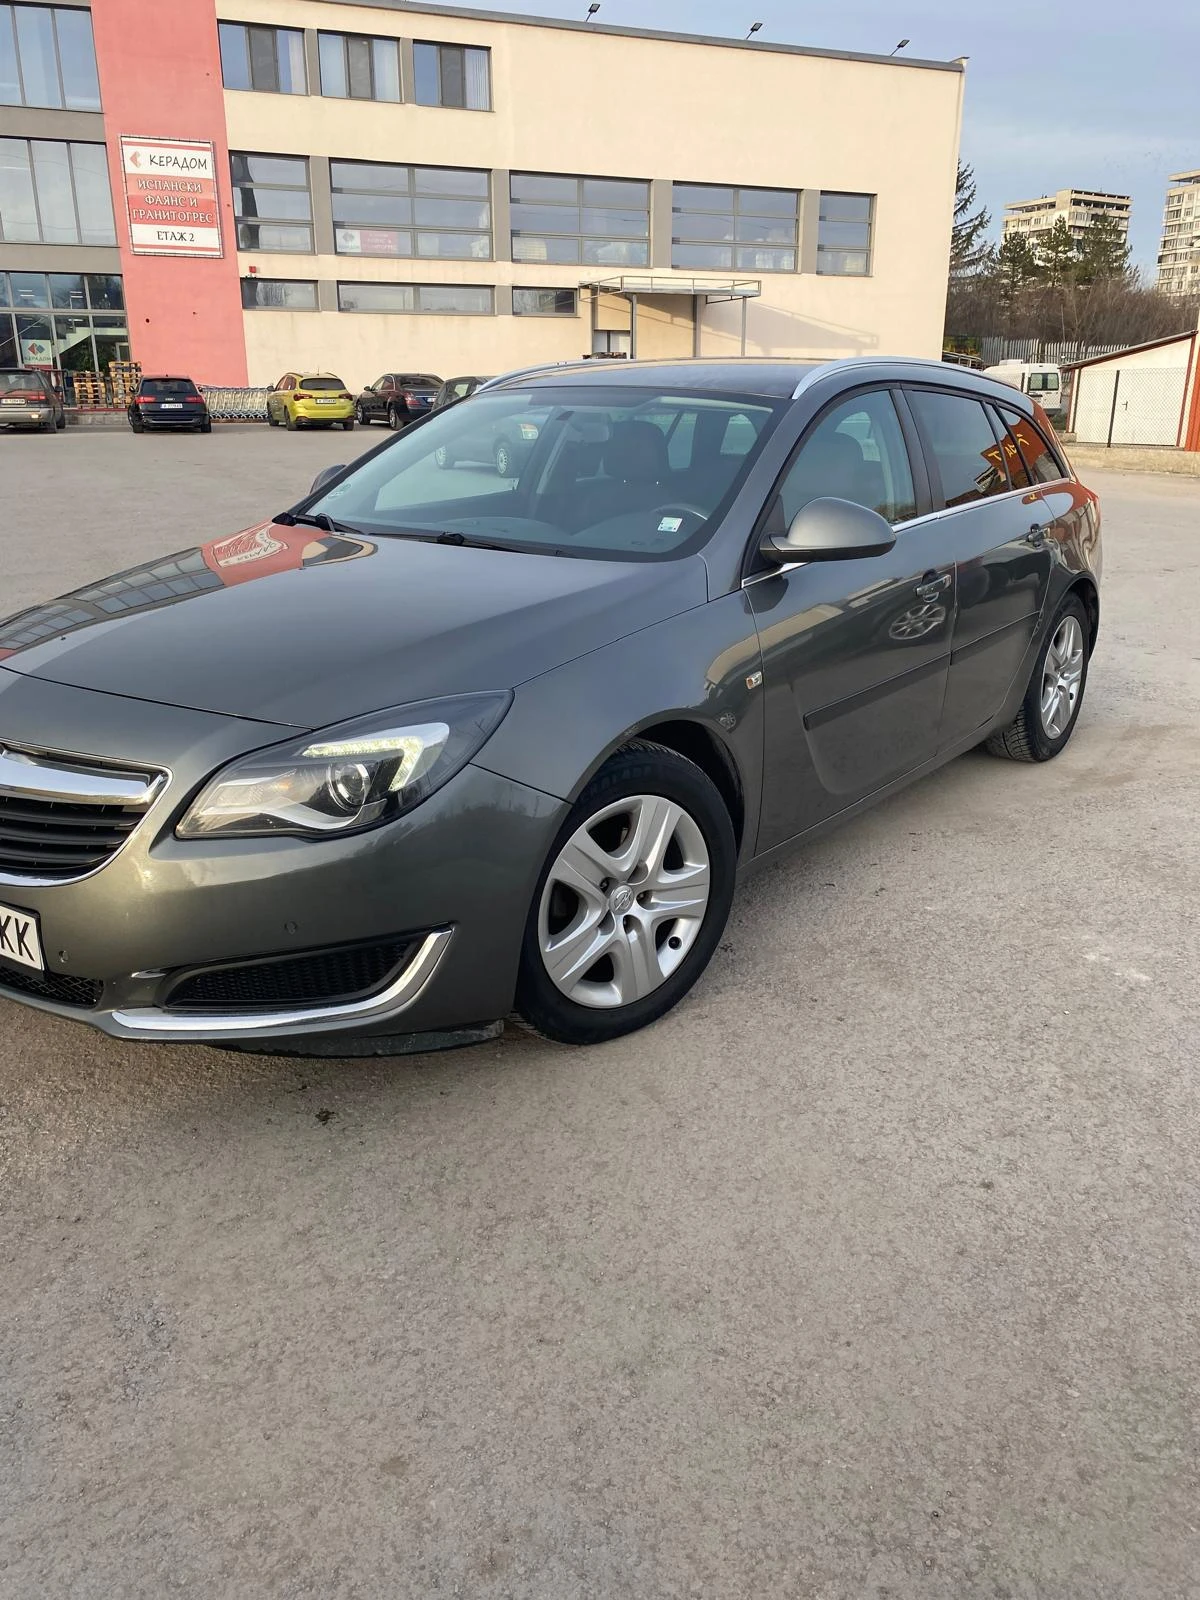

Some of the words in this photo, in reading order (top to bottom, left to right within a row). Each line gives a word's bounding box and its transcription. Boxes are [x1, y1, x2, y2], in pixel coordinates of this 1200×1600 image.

[149, 154, 208, 172] КЕРАДОМ
[138, 179, 202, 194] ИСПАНСКИ
[144, 193, 187, 208] ФАЯНС
[189, 196, 198, 207] И
[132, 209, 213, 223] ГРАНИТОГРЕС
[156, 230, 187, 242] ЕТАЖ
[189, 232, 195, 242] 2
